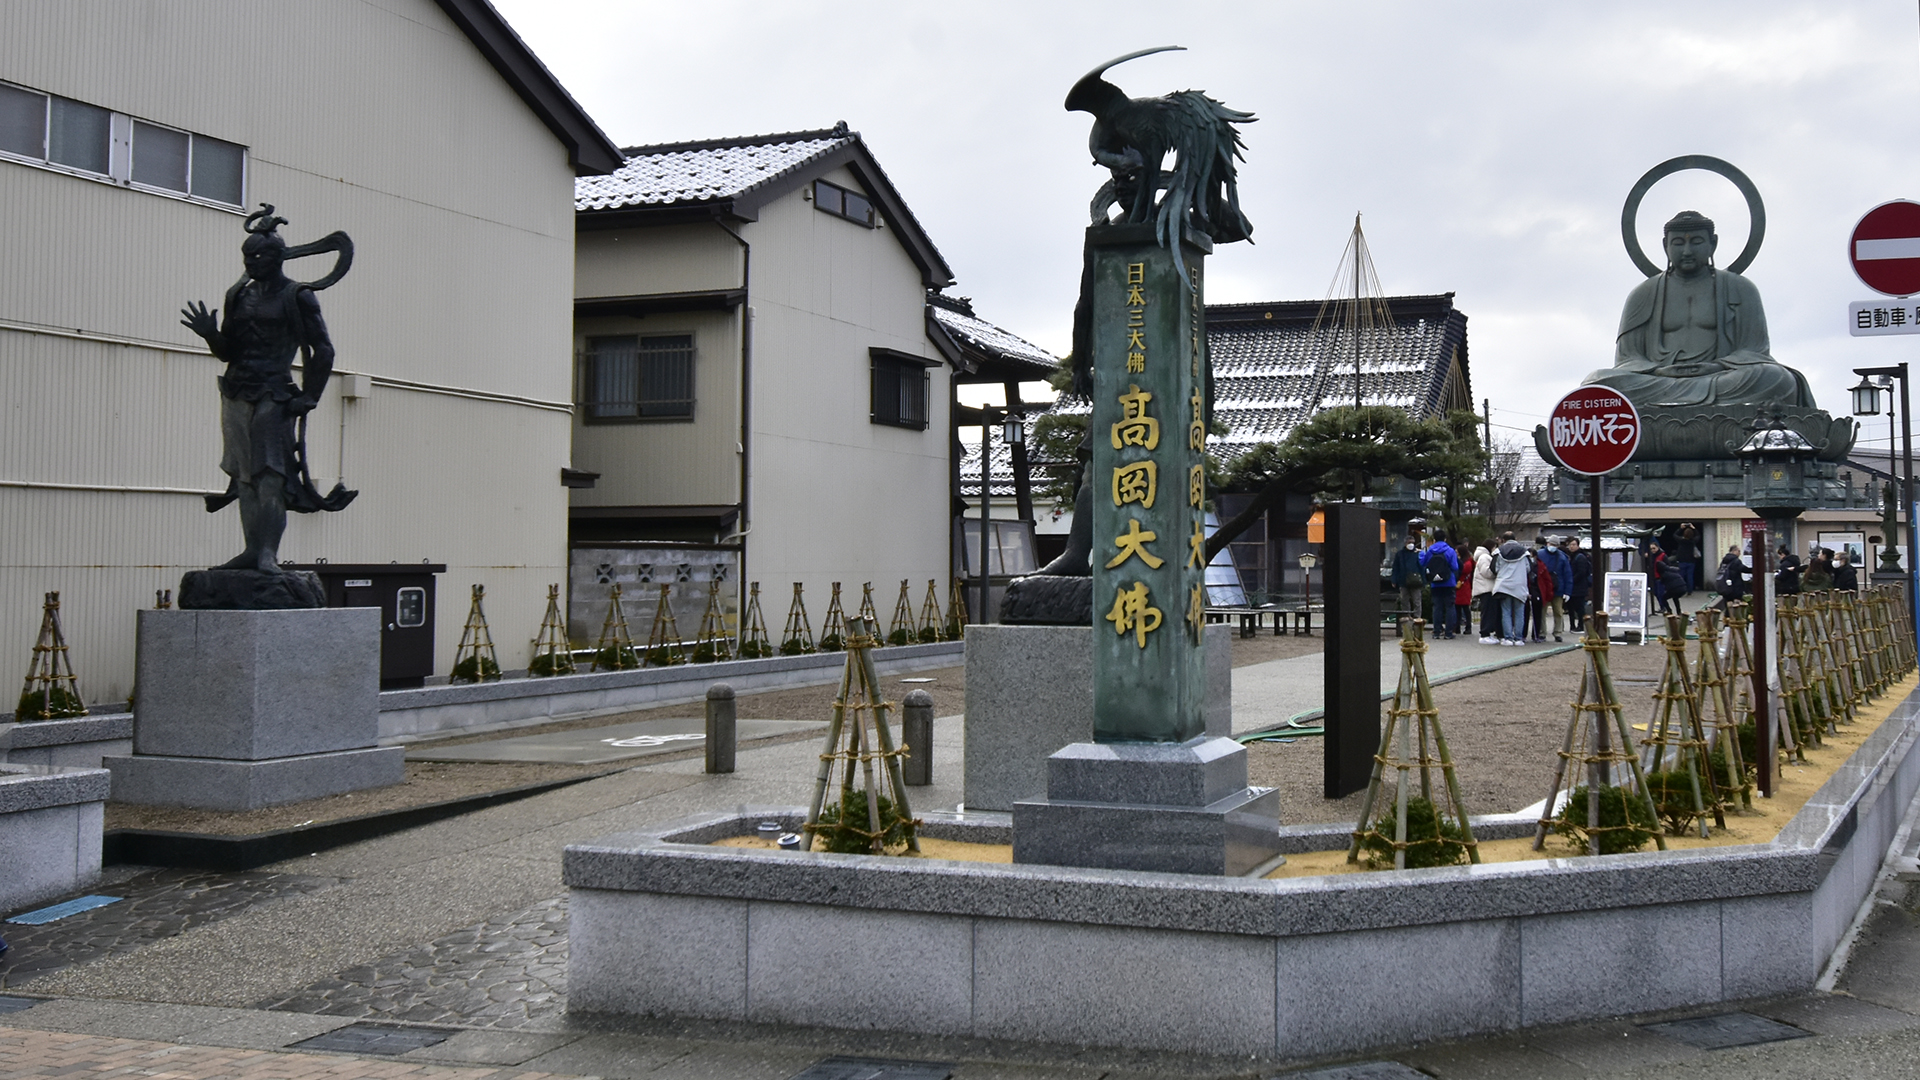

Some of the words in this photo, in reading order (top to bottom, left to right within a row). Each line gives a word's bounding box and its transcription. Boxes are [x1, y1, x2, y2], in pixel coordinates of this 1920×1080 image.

[1126, 262, 1146, 374] 日本三大佛
[1563, 400, 1582, 410] FIRE
[1584, 398, 1622, 409] CISTERN
[1552, 413, 1635, 448] 防火水そう
